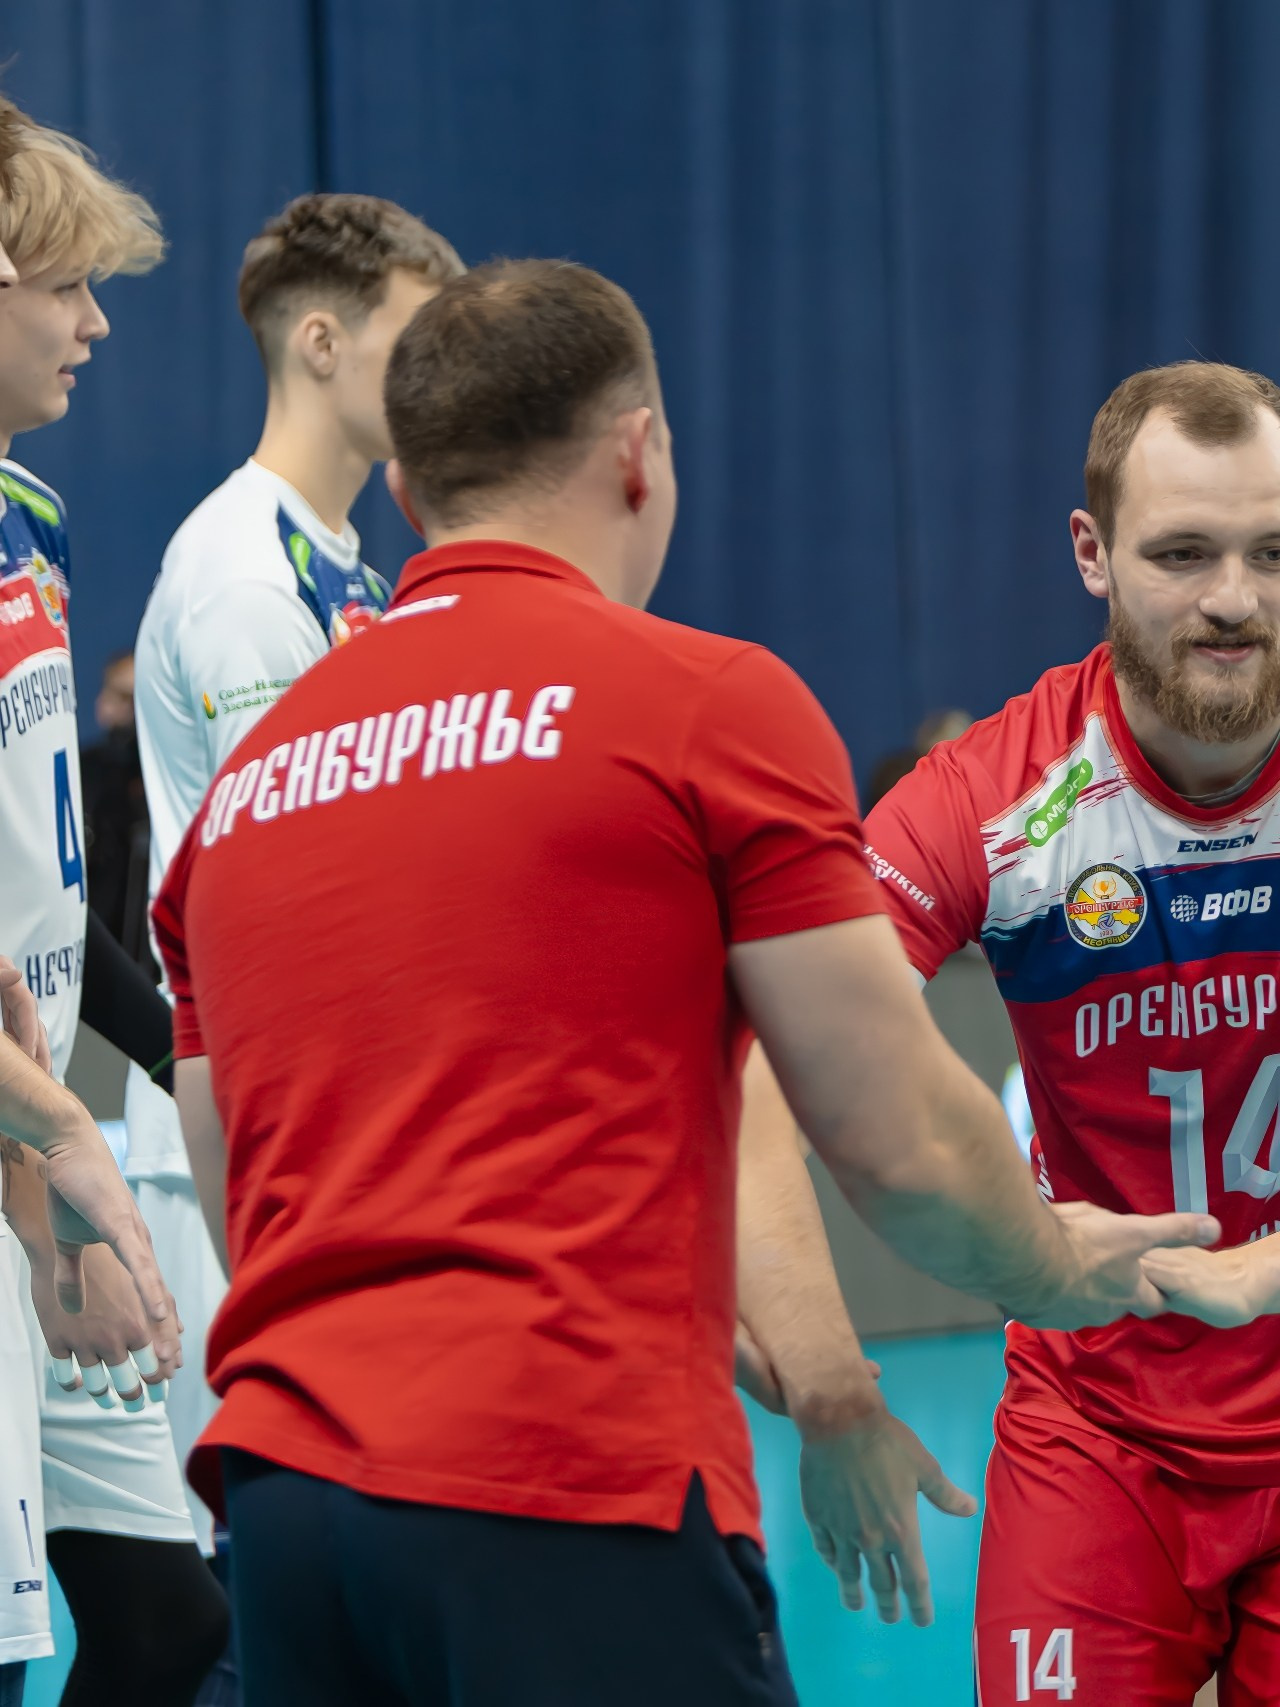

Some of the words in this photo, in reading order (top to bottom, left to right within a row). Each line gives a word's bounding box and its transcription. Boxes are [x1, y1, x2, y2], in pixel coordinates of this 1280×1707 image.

[201, 684, 577, 849] ОРЕНБУРЖЬЕ
[53, 748, 85, 904] 4
[1177, 832, 1259, 853] ENSEN
[1201, 885, 1273, 921] ВФВ
[1009, 1627, 1077, 1702] 14
